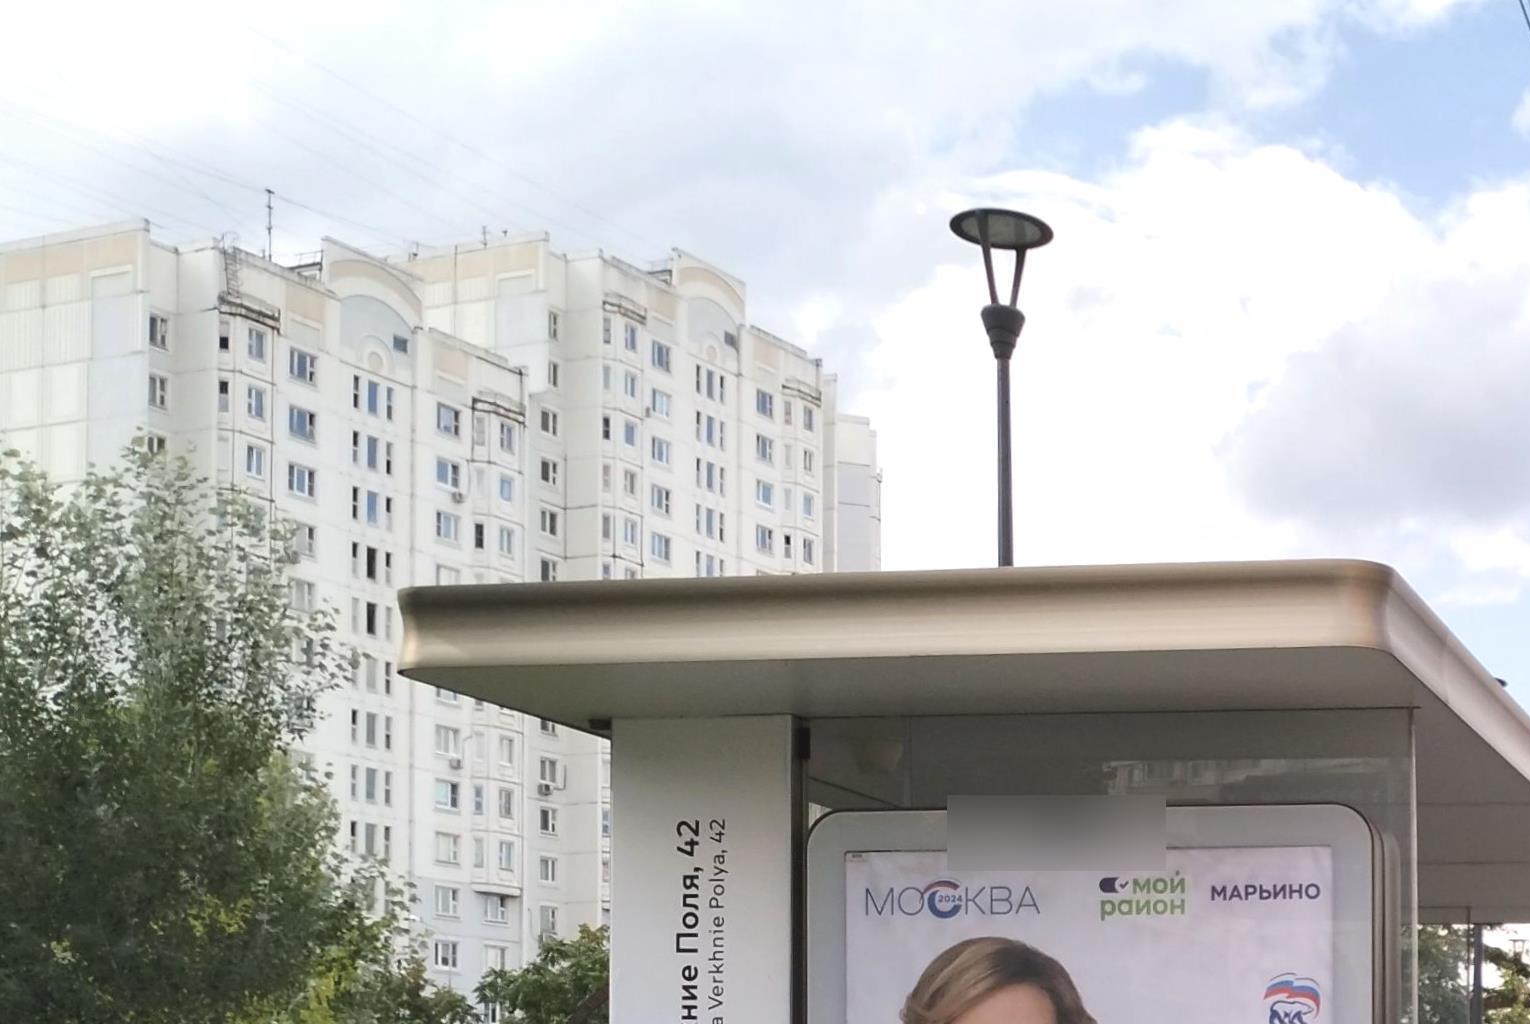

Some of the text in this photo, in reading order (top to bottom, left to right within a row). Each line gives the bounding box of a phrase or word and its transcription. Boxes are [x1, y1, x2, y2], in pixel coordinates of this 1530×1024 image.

[674, 819, 700, 858] 42
[708, 818, 726, 844] 42
[708, 848, 729, 909] Polya,
[1210, 883, 1321, 902] МАРЬИНО
[674, 865, 705, 955] Поля,
[864, 879, 1041, 919] МОСКВА
[938, 894, 963, 904] 2024
[707, 917, 726, 1012] Verkhnie
